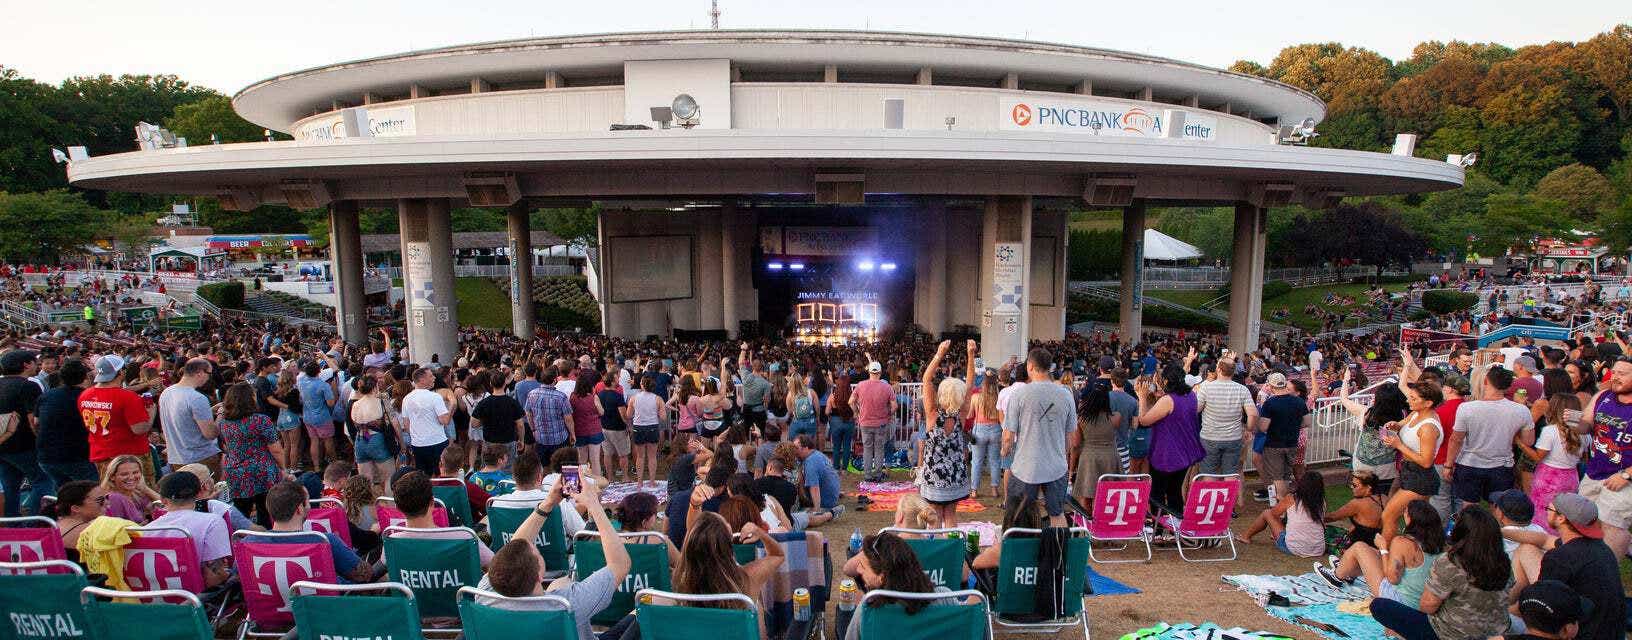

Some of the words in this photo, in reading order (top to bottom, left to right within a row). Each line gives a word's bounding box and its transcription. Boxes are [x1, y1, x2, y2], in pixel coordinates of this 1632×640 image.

[1185, 123, 1211, 139] enter
[230, 240, 249, 248] BEER
[1615, 431, 1632, 443] 15
[1104, 488, 1139, 525] T
[1195, 488, 1228, 525] T
[252, 556, 314, 612] T
[400, 568, 465, 589] RENTAL
[10, 612, 84, 637] RENTAL
